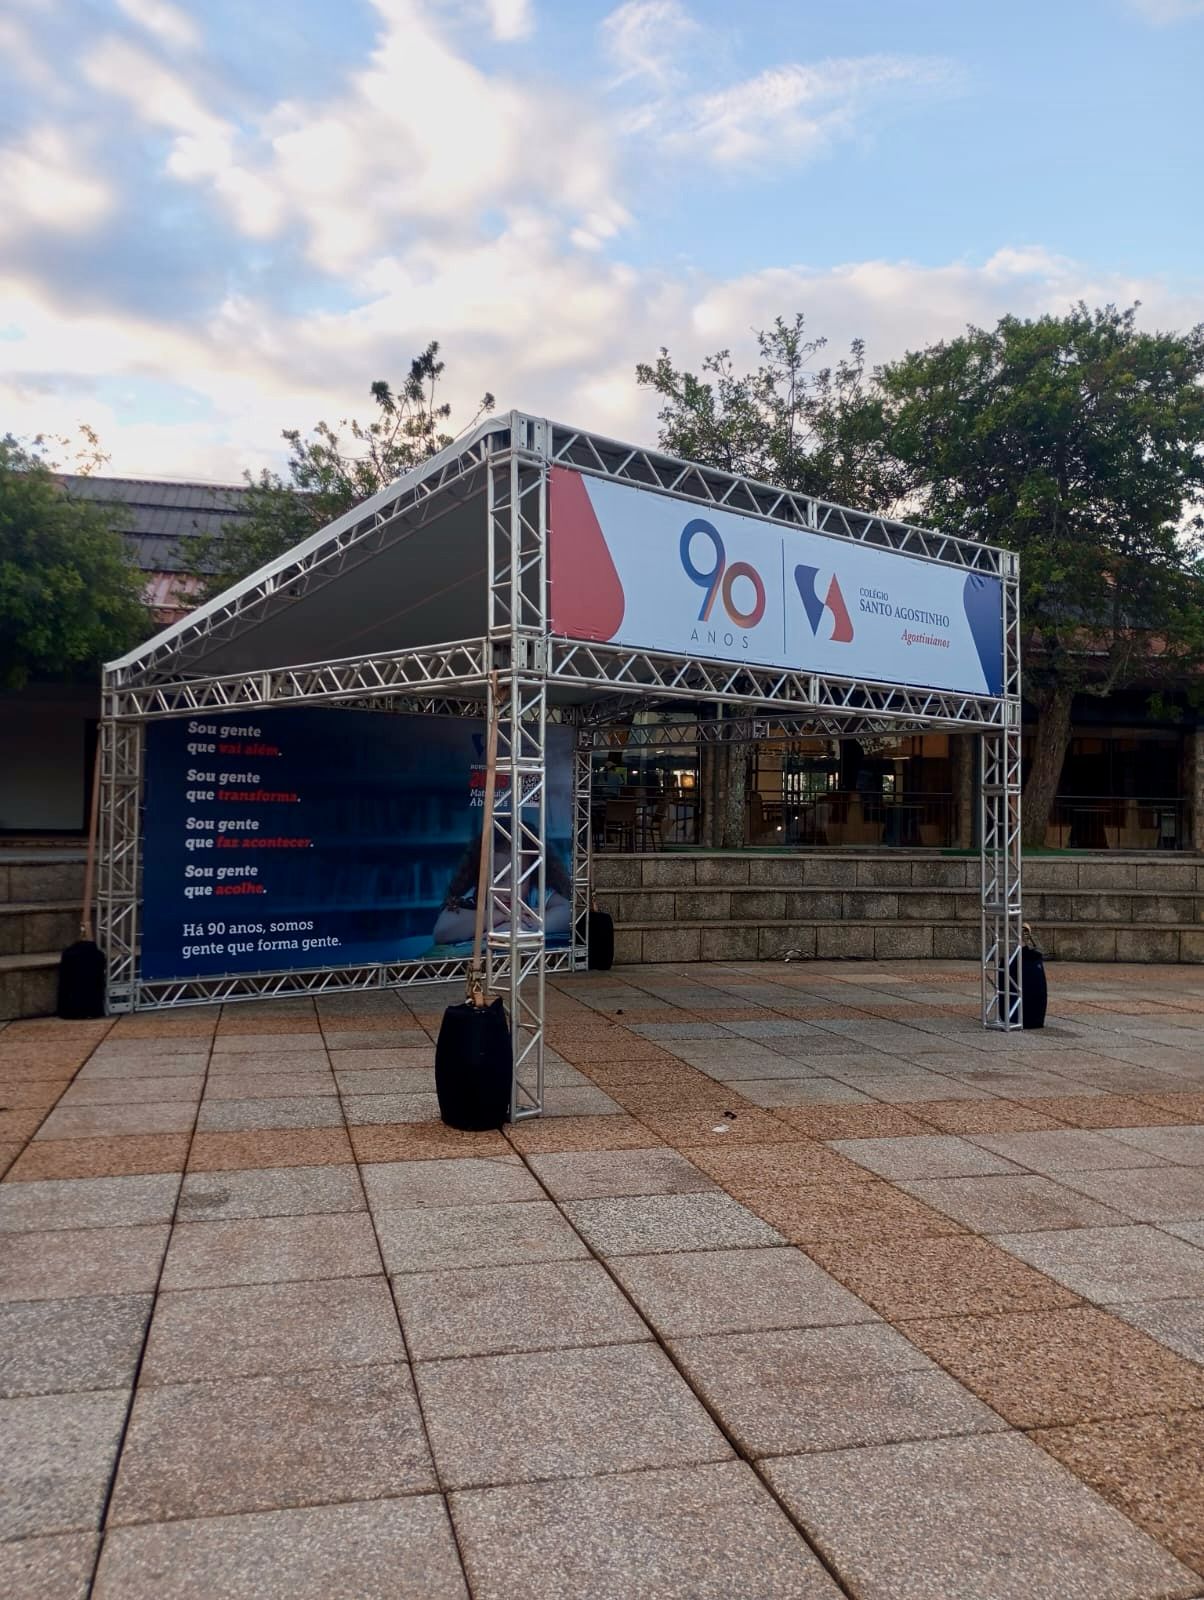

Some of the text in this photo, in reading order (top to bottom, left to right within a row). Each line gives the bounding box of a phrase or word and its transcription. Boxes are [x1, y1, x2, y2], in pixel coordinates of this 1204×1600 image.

[679, 518, 766, 629] 90
[859, 587, 889, 602] COLÉGIO
[859, 599, 950, 628] SANTO AGOSTINHO
[690, 630, 749, 649] ANOS
[901, 628, 950, 649] Agostinianos
[187, 720, 262, 739] Sou gente
[187, 741, 216, 755] que
[186, 768, 261, 785] Sou gente
[186, 789, 301, 803] que transforma.
[185, 816, 260, 832] Sou gente
[184, 835, 314, 851] que faz acontecer.
[184, 864, 259, 879] Sou gente
[184, 882, 267, 899] que acolhe.
[182, 920, 314, 937] Há 90 anos, somos
[182, 935, 342, 959] gente que forma gente.
